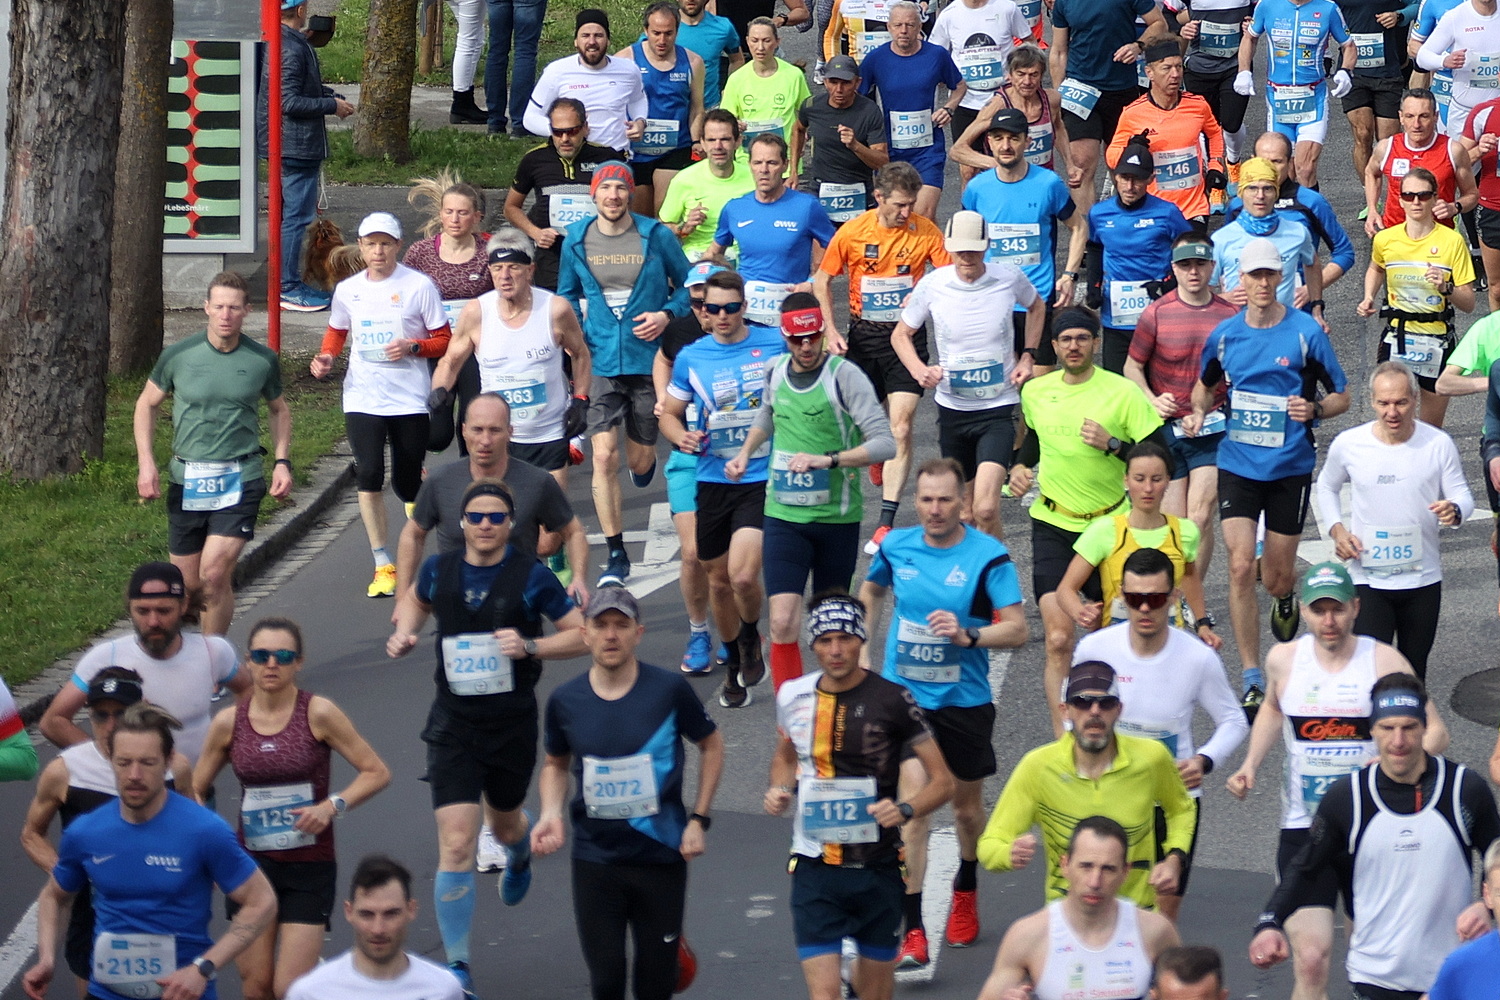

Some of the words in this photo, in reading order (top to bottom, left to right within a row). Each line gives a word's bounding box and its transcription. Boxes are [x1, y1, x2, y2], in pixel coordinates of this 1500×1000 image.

[1214, 35, 1227, 46] 11
[970, 66, 992, 77] 312
[1065, 88, 1087, 101] 207
[1284, 99, 1306, 111] 177
[897, 124, 925, 135] 2190
[644, 132, 667, 144] 348
[1166, 163, 1190, 176] 146
[830, 197, 854, 209] 422
[1001, 239, 1028, 252] 343
[873, 292, 901, 306] 353
[361, 333, 393, 345] 2102
[962, 369, 991, 383] 440
[505, 389, 534, 404] 363
[1243, 411, 1271, 427] 332
[197, 479, 226, 493] 281
[784, 472, 814, 488] 143
[1373, 545, 1413, 559] 2185
[909, 646, 944, 663] 405
[454, 657, 497, 673] 2240
[594, 780, 642, 798] 2072
[820, 802, 858, 821] 112
[107, 958, 162, 976] 2135
